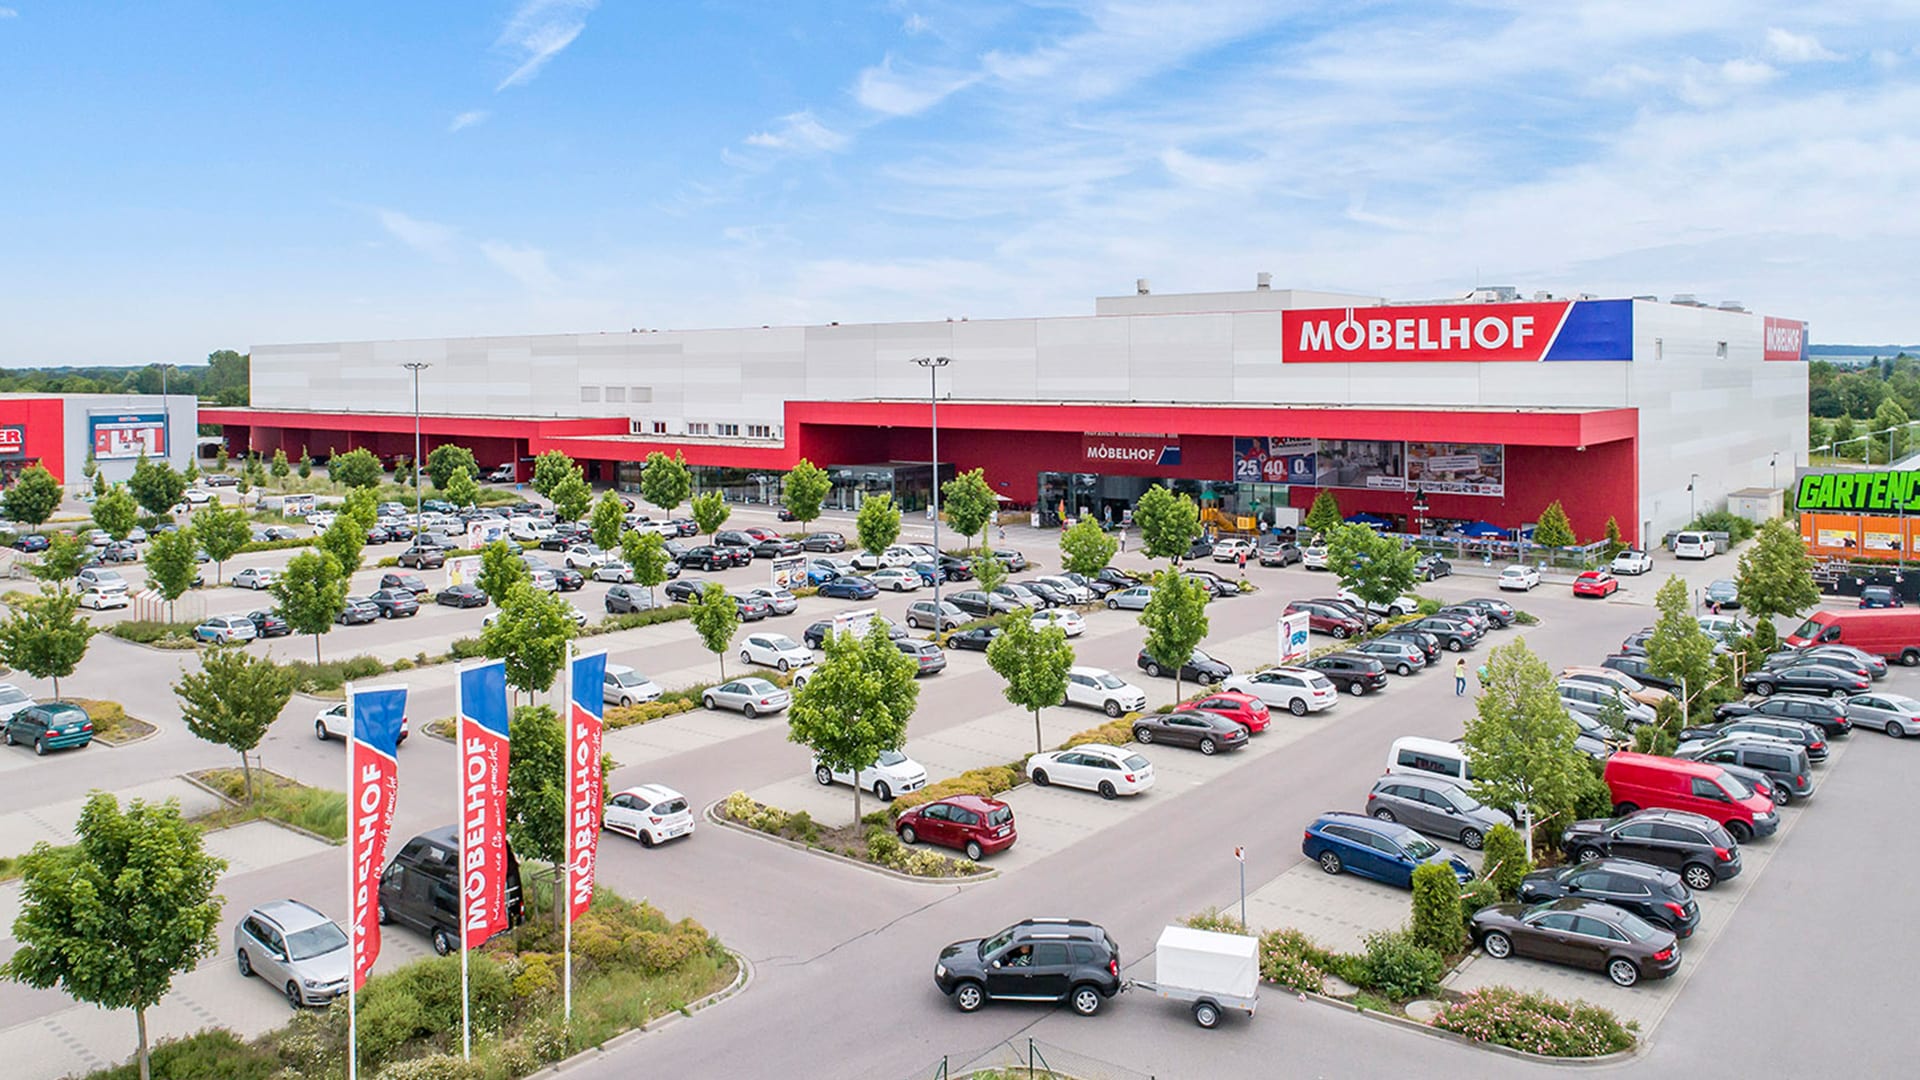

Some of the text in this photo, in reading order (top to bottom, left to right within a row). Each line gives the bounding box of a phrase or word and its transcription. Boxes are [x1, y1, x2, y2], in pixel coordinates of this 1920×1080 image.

[1299, 308, 1534, 351] MÖBELHOF
[1087, 443, 1156, 460] MÖBELHOF
[465, 737, 488, 931] MÖBELHOF
